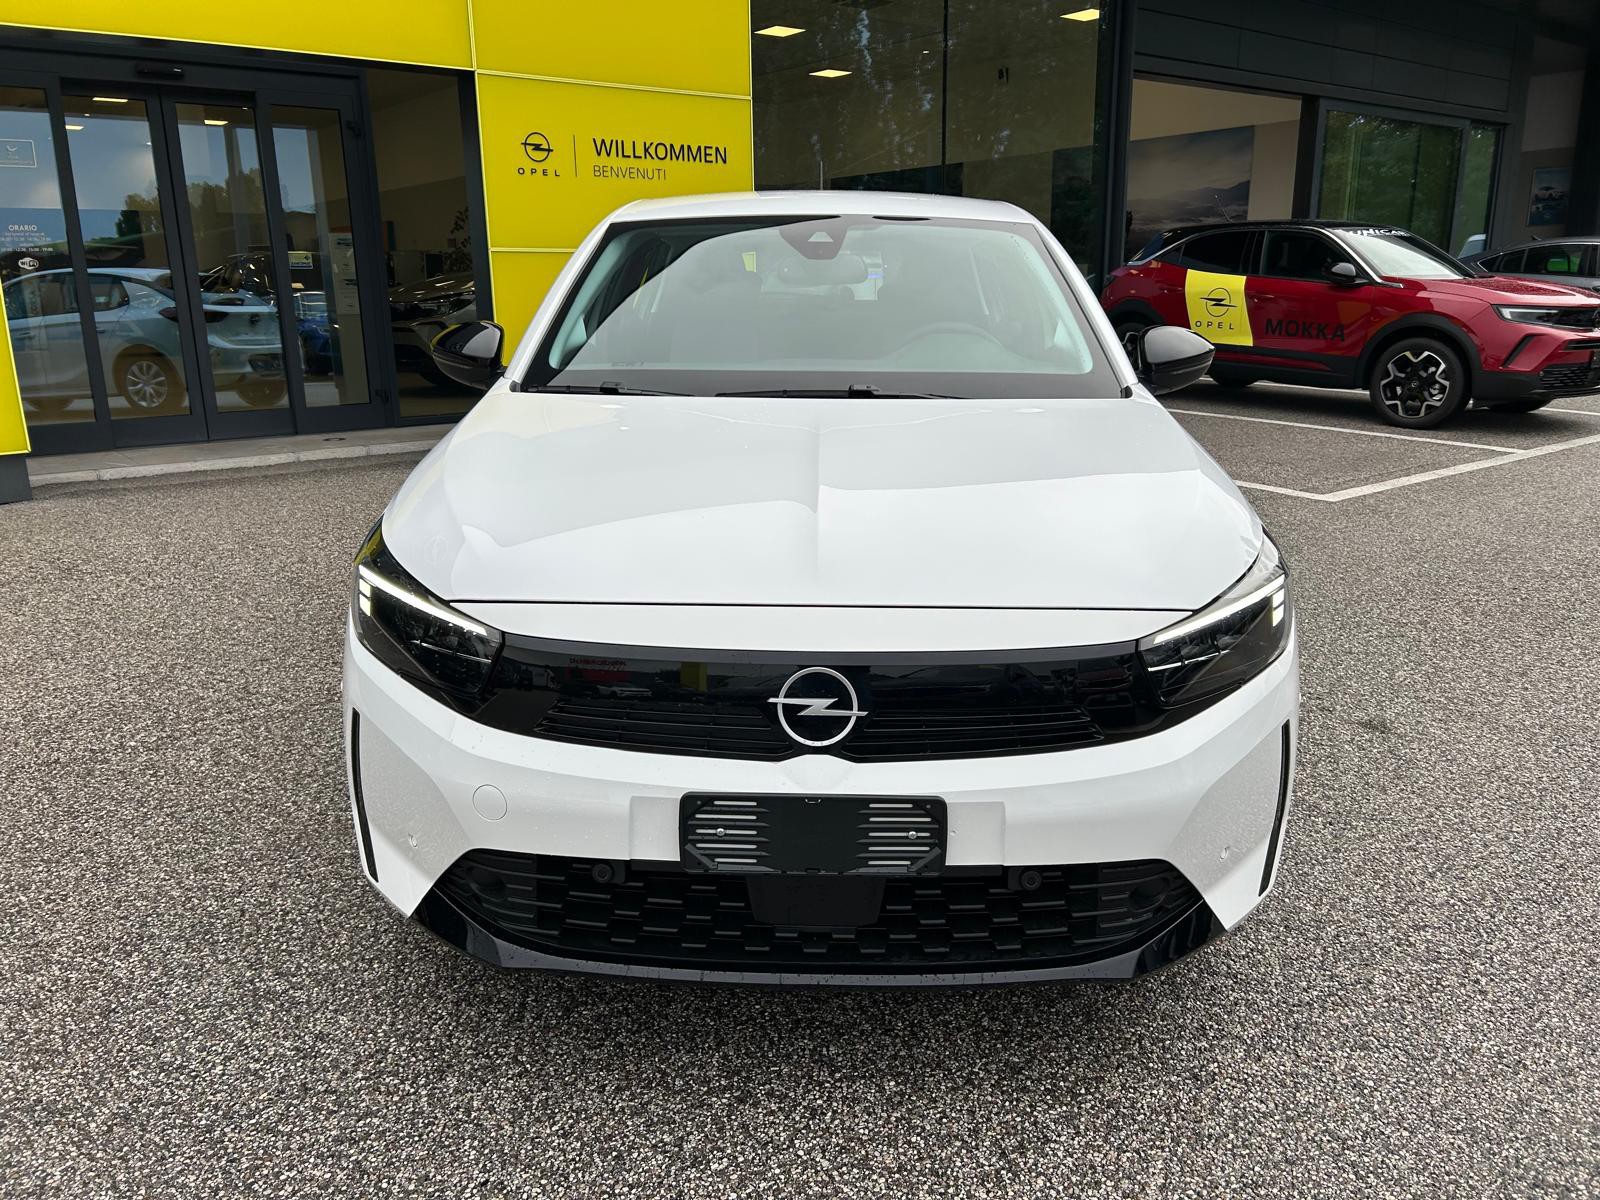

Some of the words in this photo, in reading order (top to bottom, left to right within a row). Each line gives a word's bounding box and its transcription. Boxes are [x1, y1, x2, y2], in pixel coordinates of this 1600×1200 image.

[592, 137, 728, 165] WILLKOMMEN
[517, 167, 561, 177] OPEL
[592, 164, 667, 181] BENVENUTI
[1194, 320, 1235, 330] OPEL
[1264, 318, 1346, 342] MOKKA
